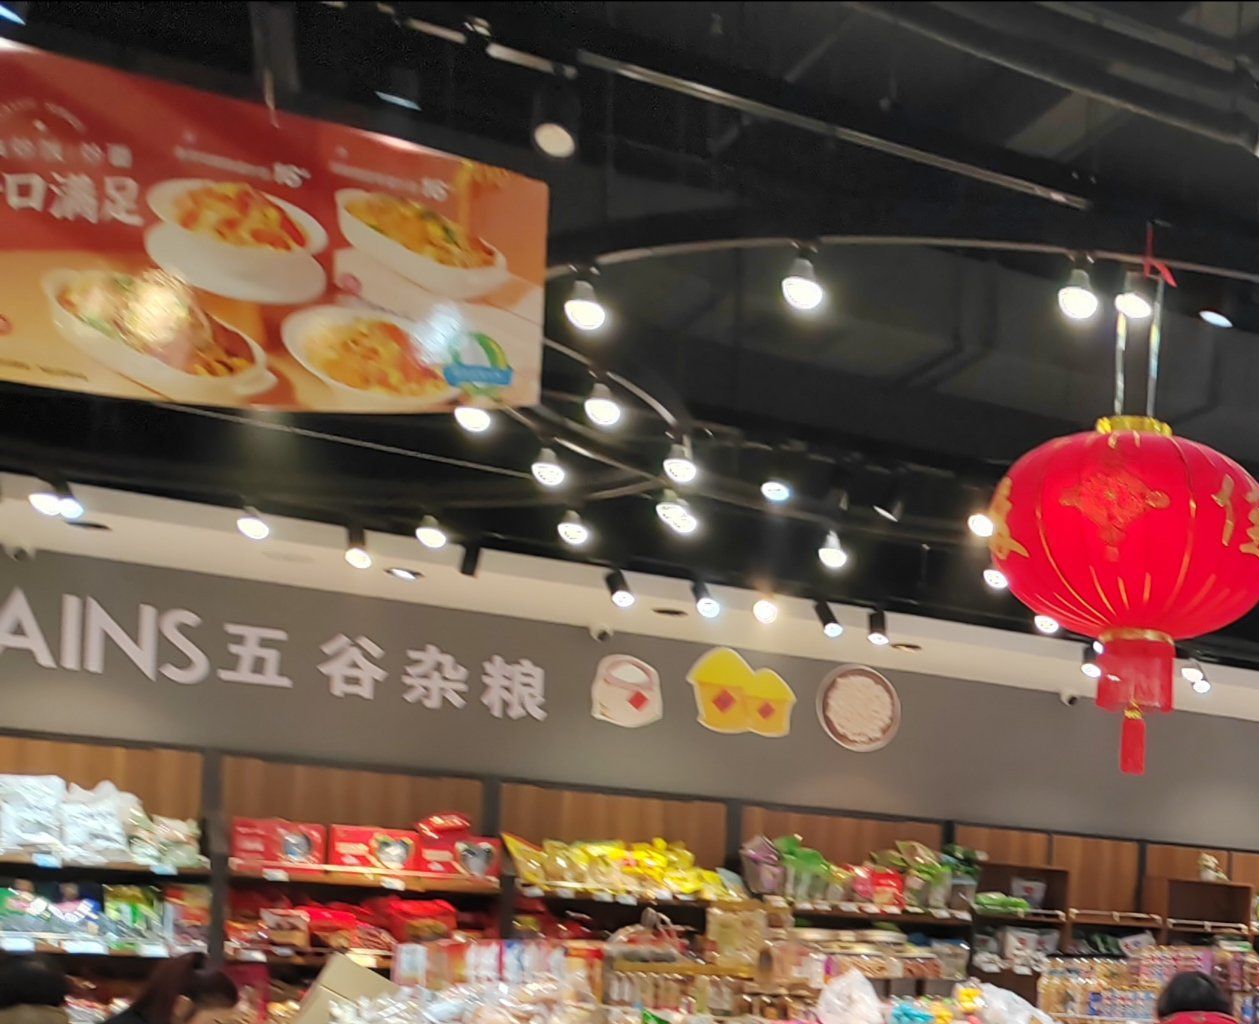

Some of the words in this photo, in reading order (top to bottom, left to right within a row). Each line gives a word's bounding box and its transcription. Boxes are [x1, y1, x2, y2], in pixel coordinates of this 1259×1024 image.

[0, 587, 210, 685] AINS
[216, 622, 549, 722] 五谷杂粮
